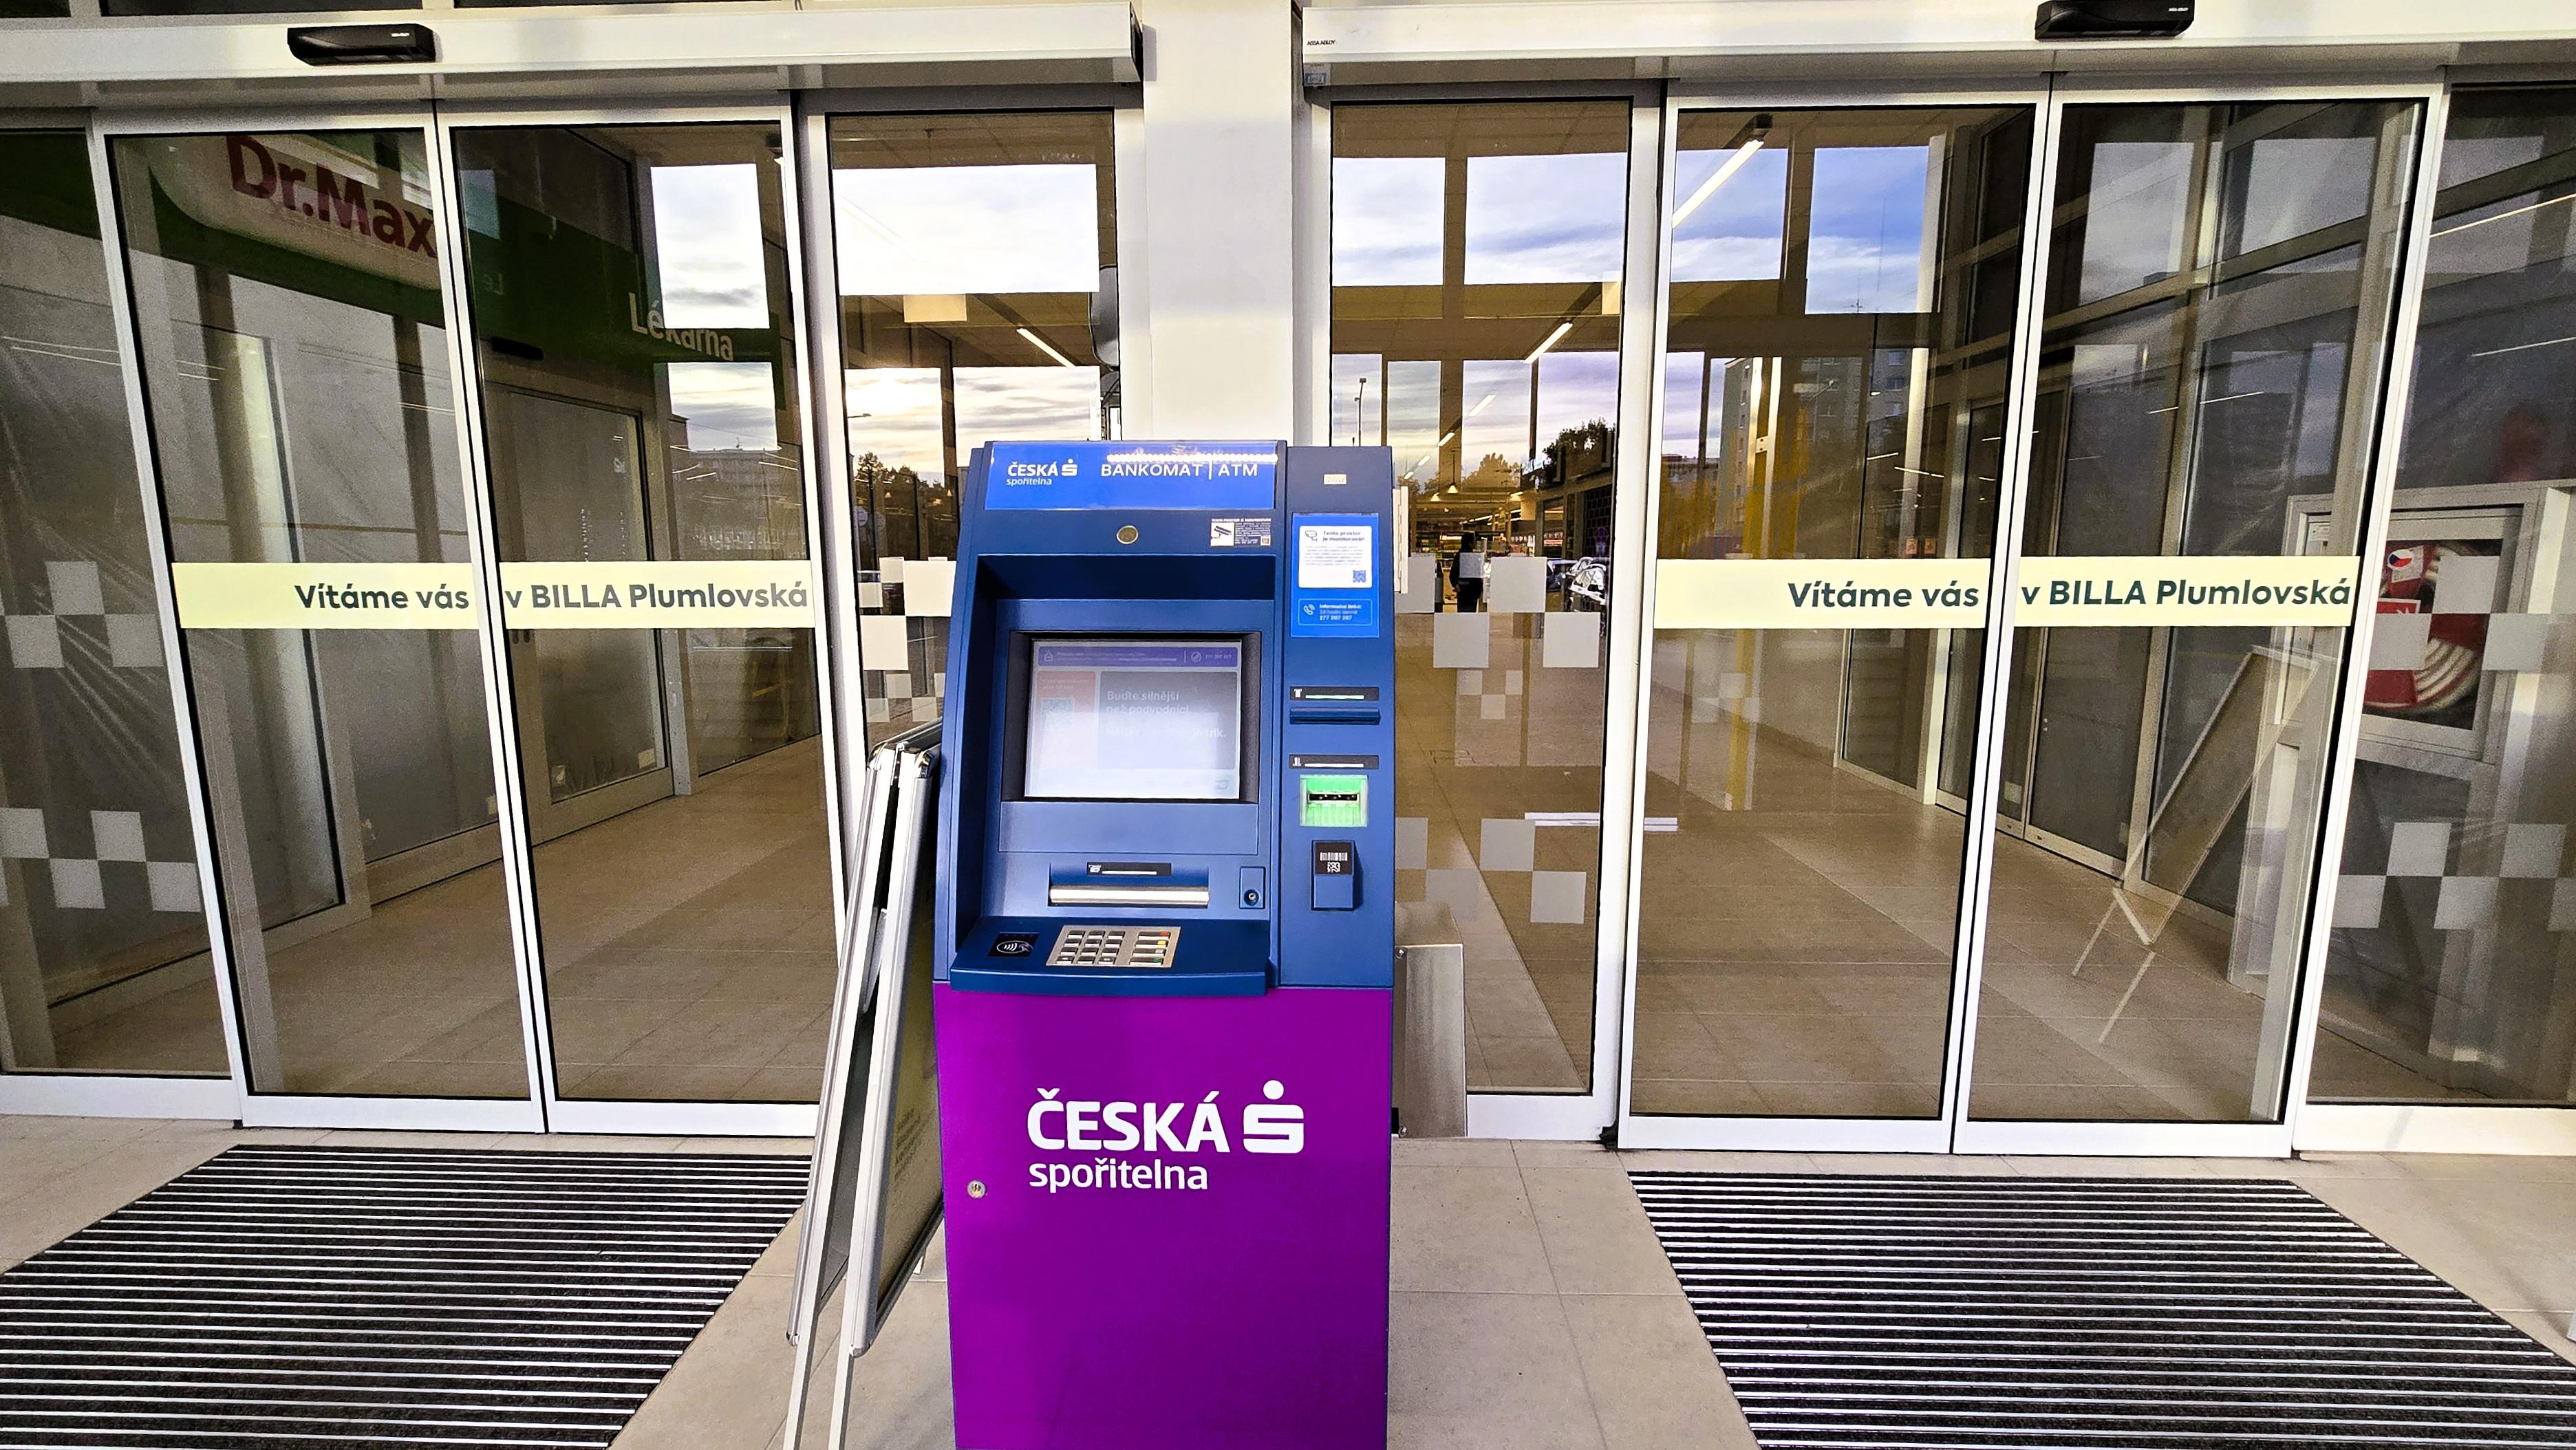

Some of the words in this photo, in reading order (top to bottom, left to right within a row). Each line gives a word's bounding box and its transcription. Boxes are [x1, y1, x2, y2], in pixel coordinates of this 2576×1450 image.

[226, 135, 438, 259] Dr.Max
[1006, 477, 1052, 487] spořitelna
[1007, 461, 1058, 477] ČESKÁ
[1101, 464, 1203, 477] BANKOMAT
[1218, 464, 1258, 477] ATM
[294, 583, 409, 609] Vítáme
[416, 583, 469, 609] vás
[504, 590, 522, 609] v
[530, 584, 622, 608] BILLA
[629, 581, 807, 609] Plumlovská
[1788, 581, 1912, 607] Vítáme
[1921, 580, 1979, 607] vás
[2021, 586, 2041, 605] v
[2049, 580, 2146, 605] BILLA
[2156, 577, 2351, 605] Plumlovská
[1027, 1088, 1230, 1153] ČESKÁ
[1029, 1157, 1208, 1193] spořitelna
